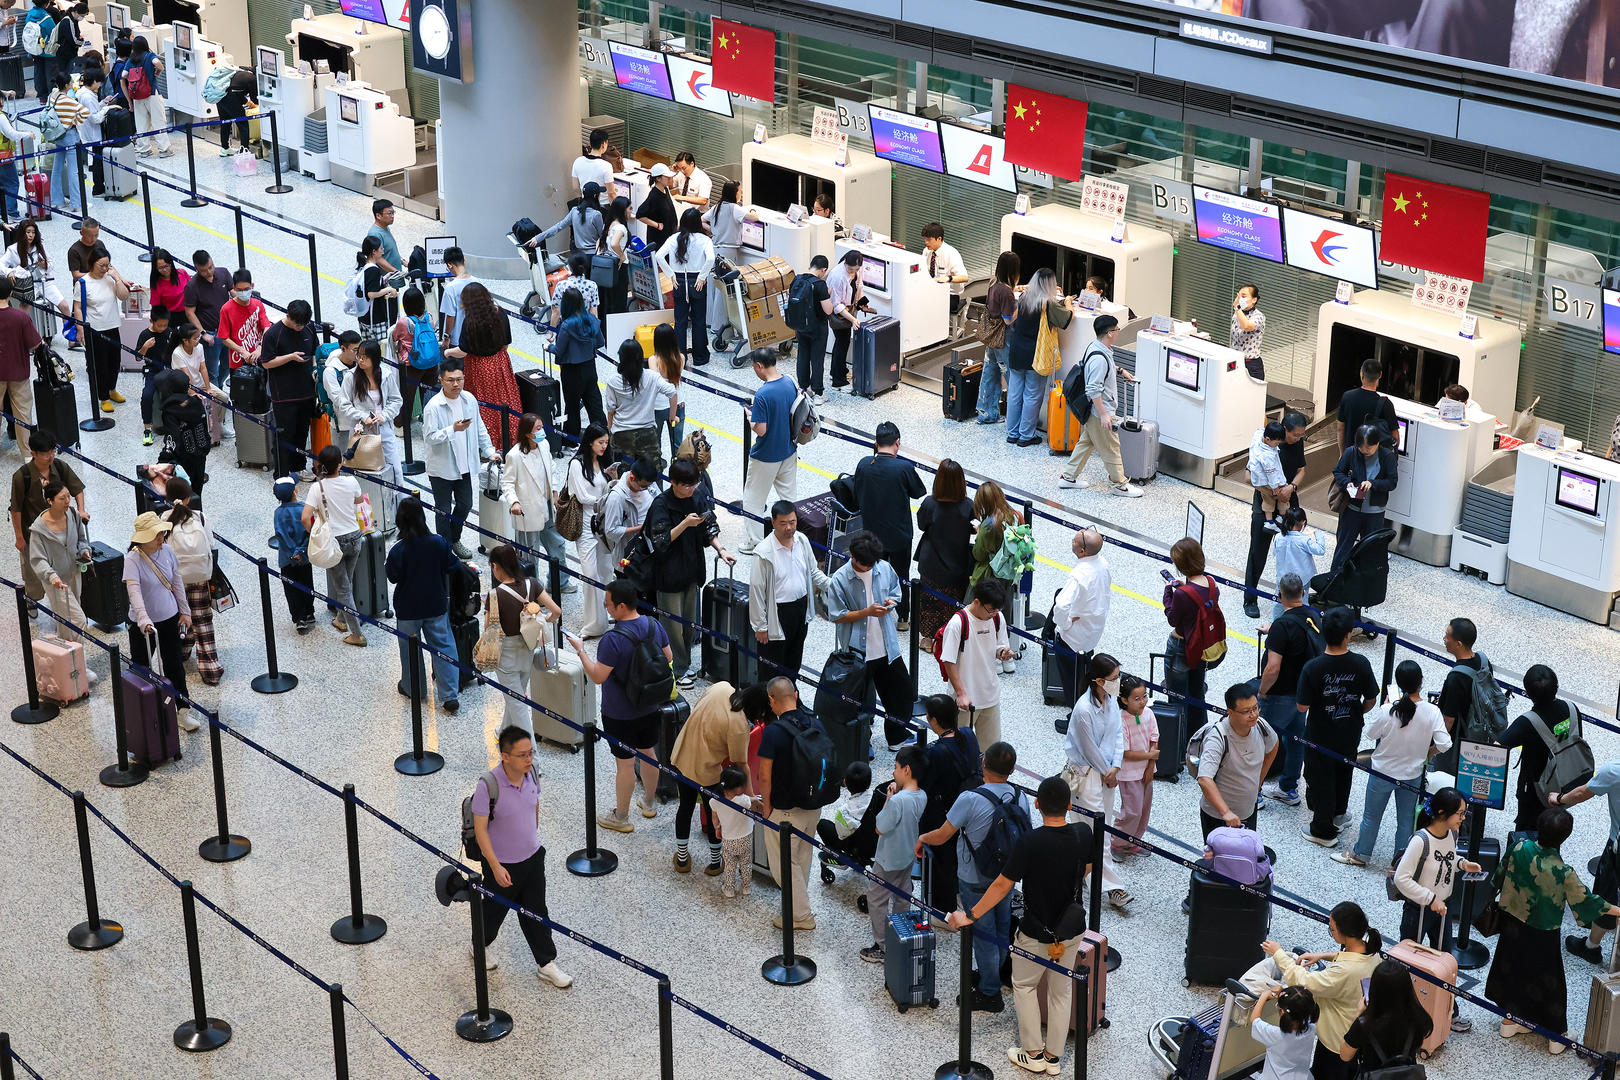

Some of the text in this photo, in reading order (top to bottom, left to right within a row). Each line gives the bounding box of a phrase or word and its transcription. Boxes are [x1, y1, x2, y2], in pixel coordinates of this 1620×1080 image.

[1219, 30, 1267, 50] JCDecaux
[584, 42, 609, 66] B11
[838, 105, 867, 132] B13
[892, 128, 919, 144] 经济舱
[890, 141, 926, 157] ECONOMY CLASS
[1154, 183, 1188, 215] B15
[1222, 211, 1254, 230] 经济舱
[1216, 226, 1261, 244] ECONOMY CLASS
[1551, 285, 1596, 320] B17
